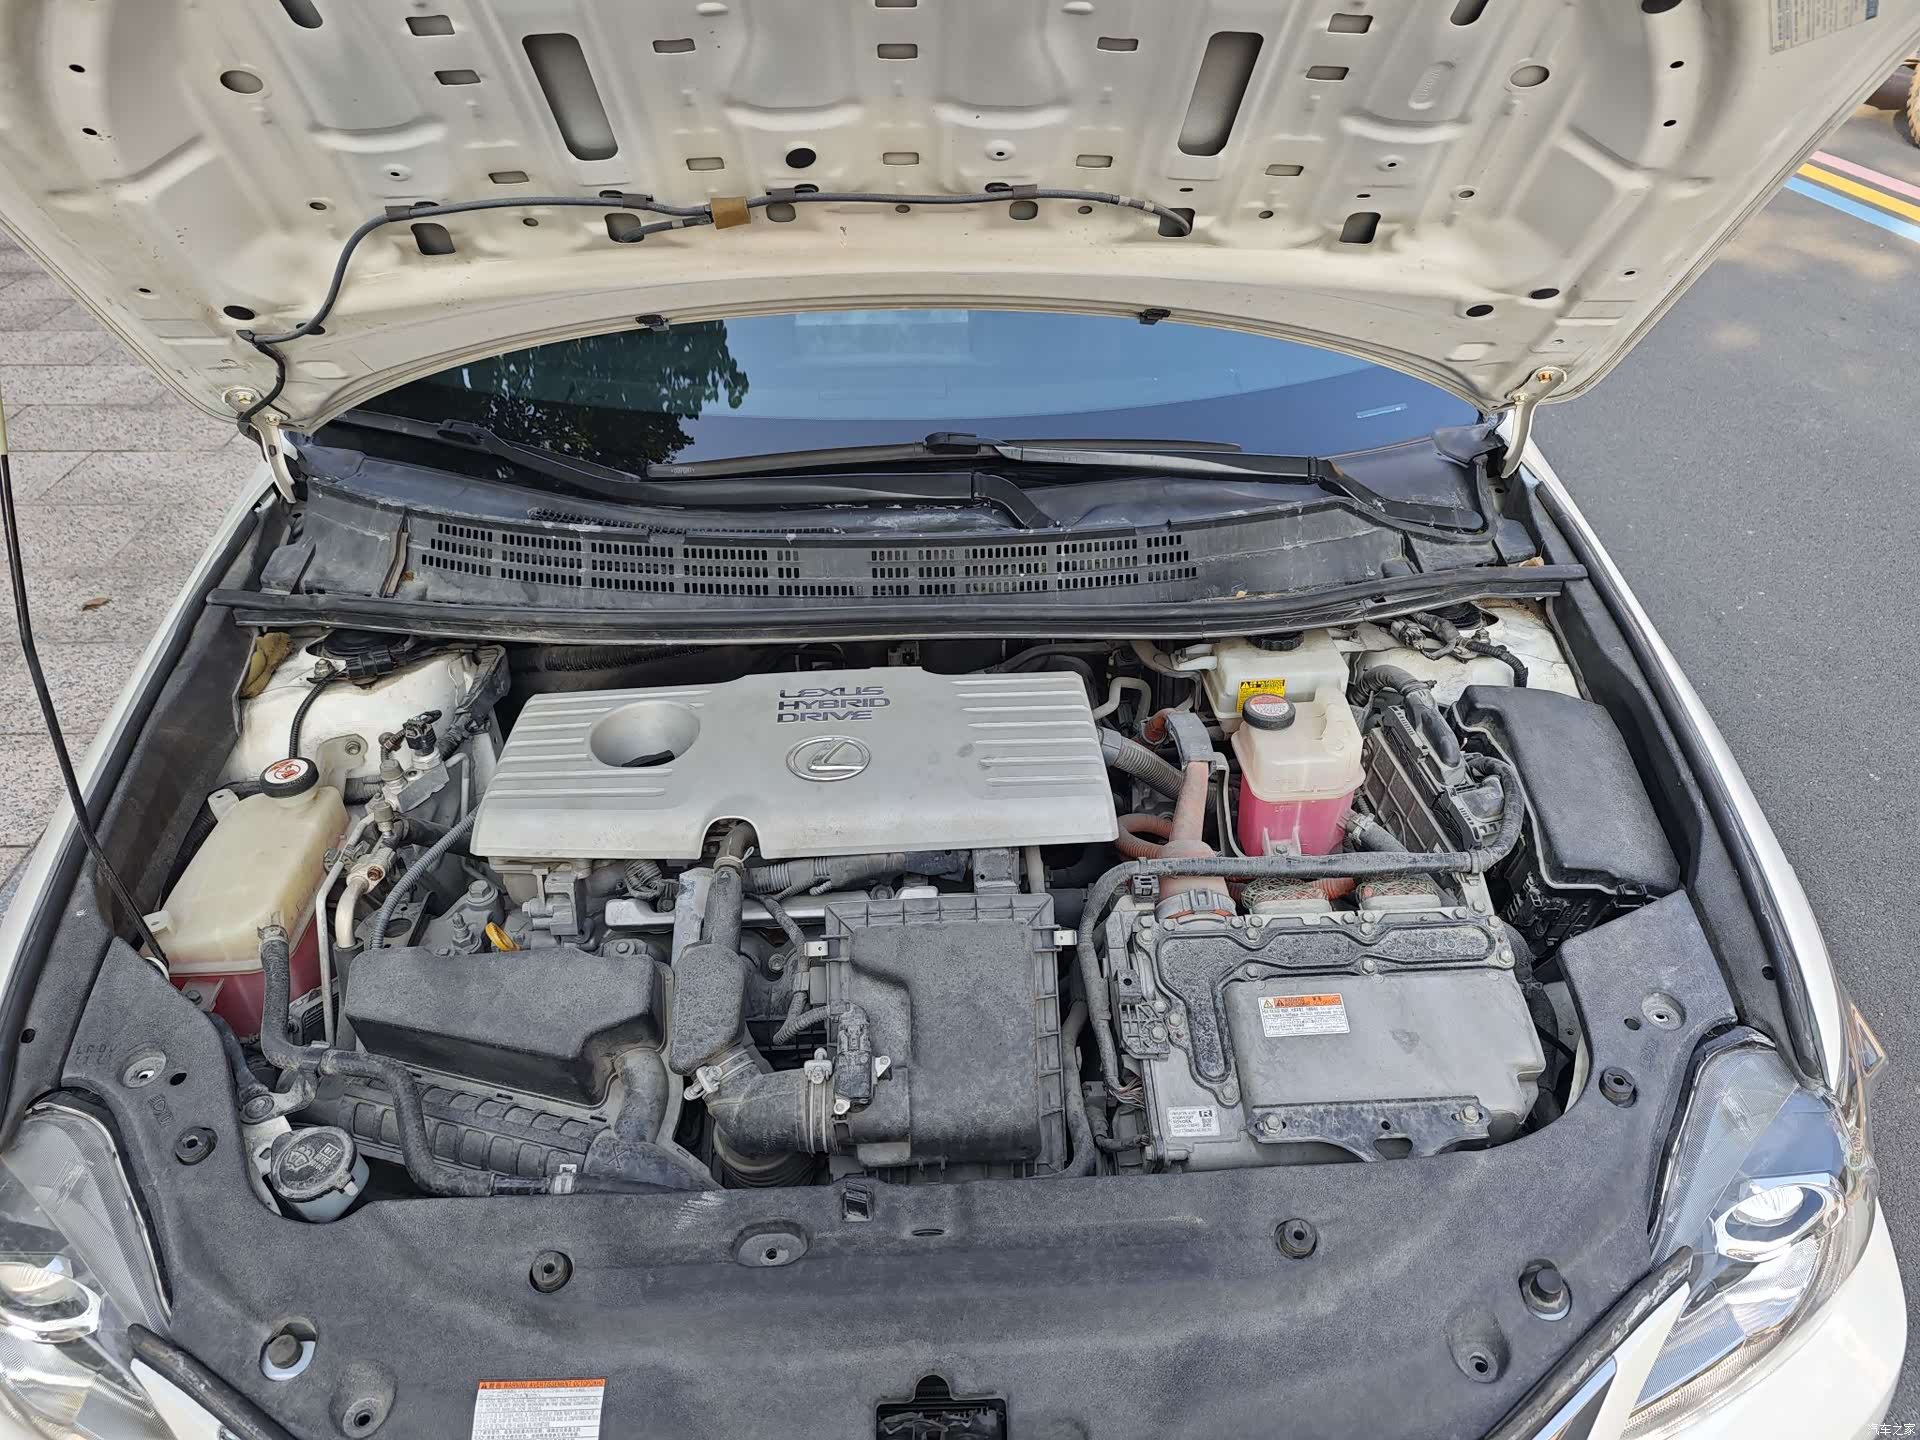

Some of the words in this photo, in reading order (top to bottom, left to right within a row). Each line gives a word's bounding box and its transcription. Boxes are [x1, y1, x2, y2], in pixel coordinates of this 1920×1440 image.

[779, 686, 885, 698] LEXUS
[778, 698, 891, 710] HYBRID
[776, 710, 873, 723] DRIVE
